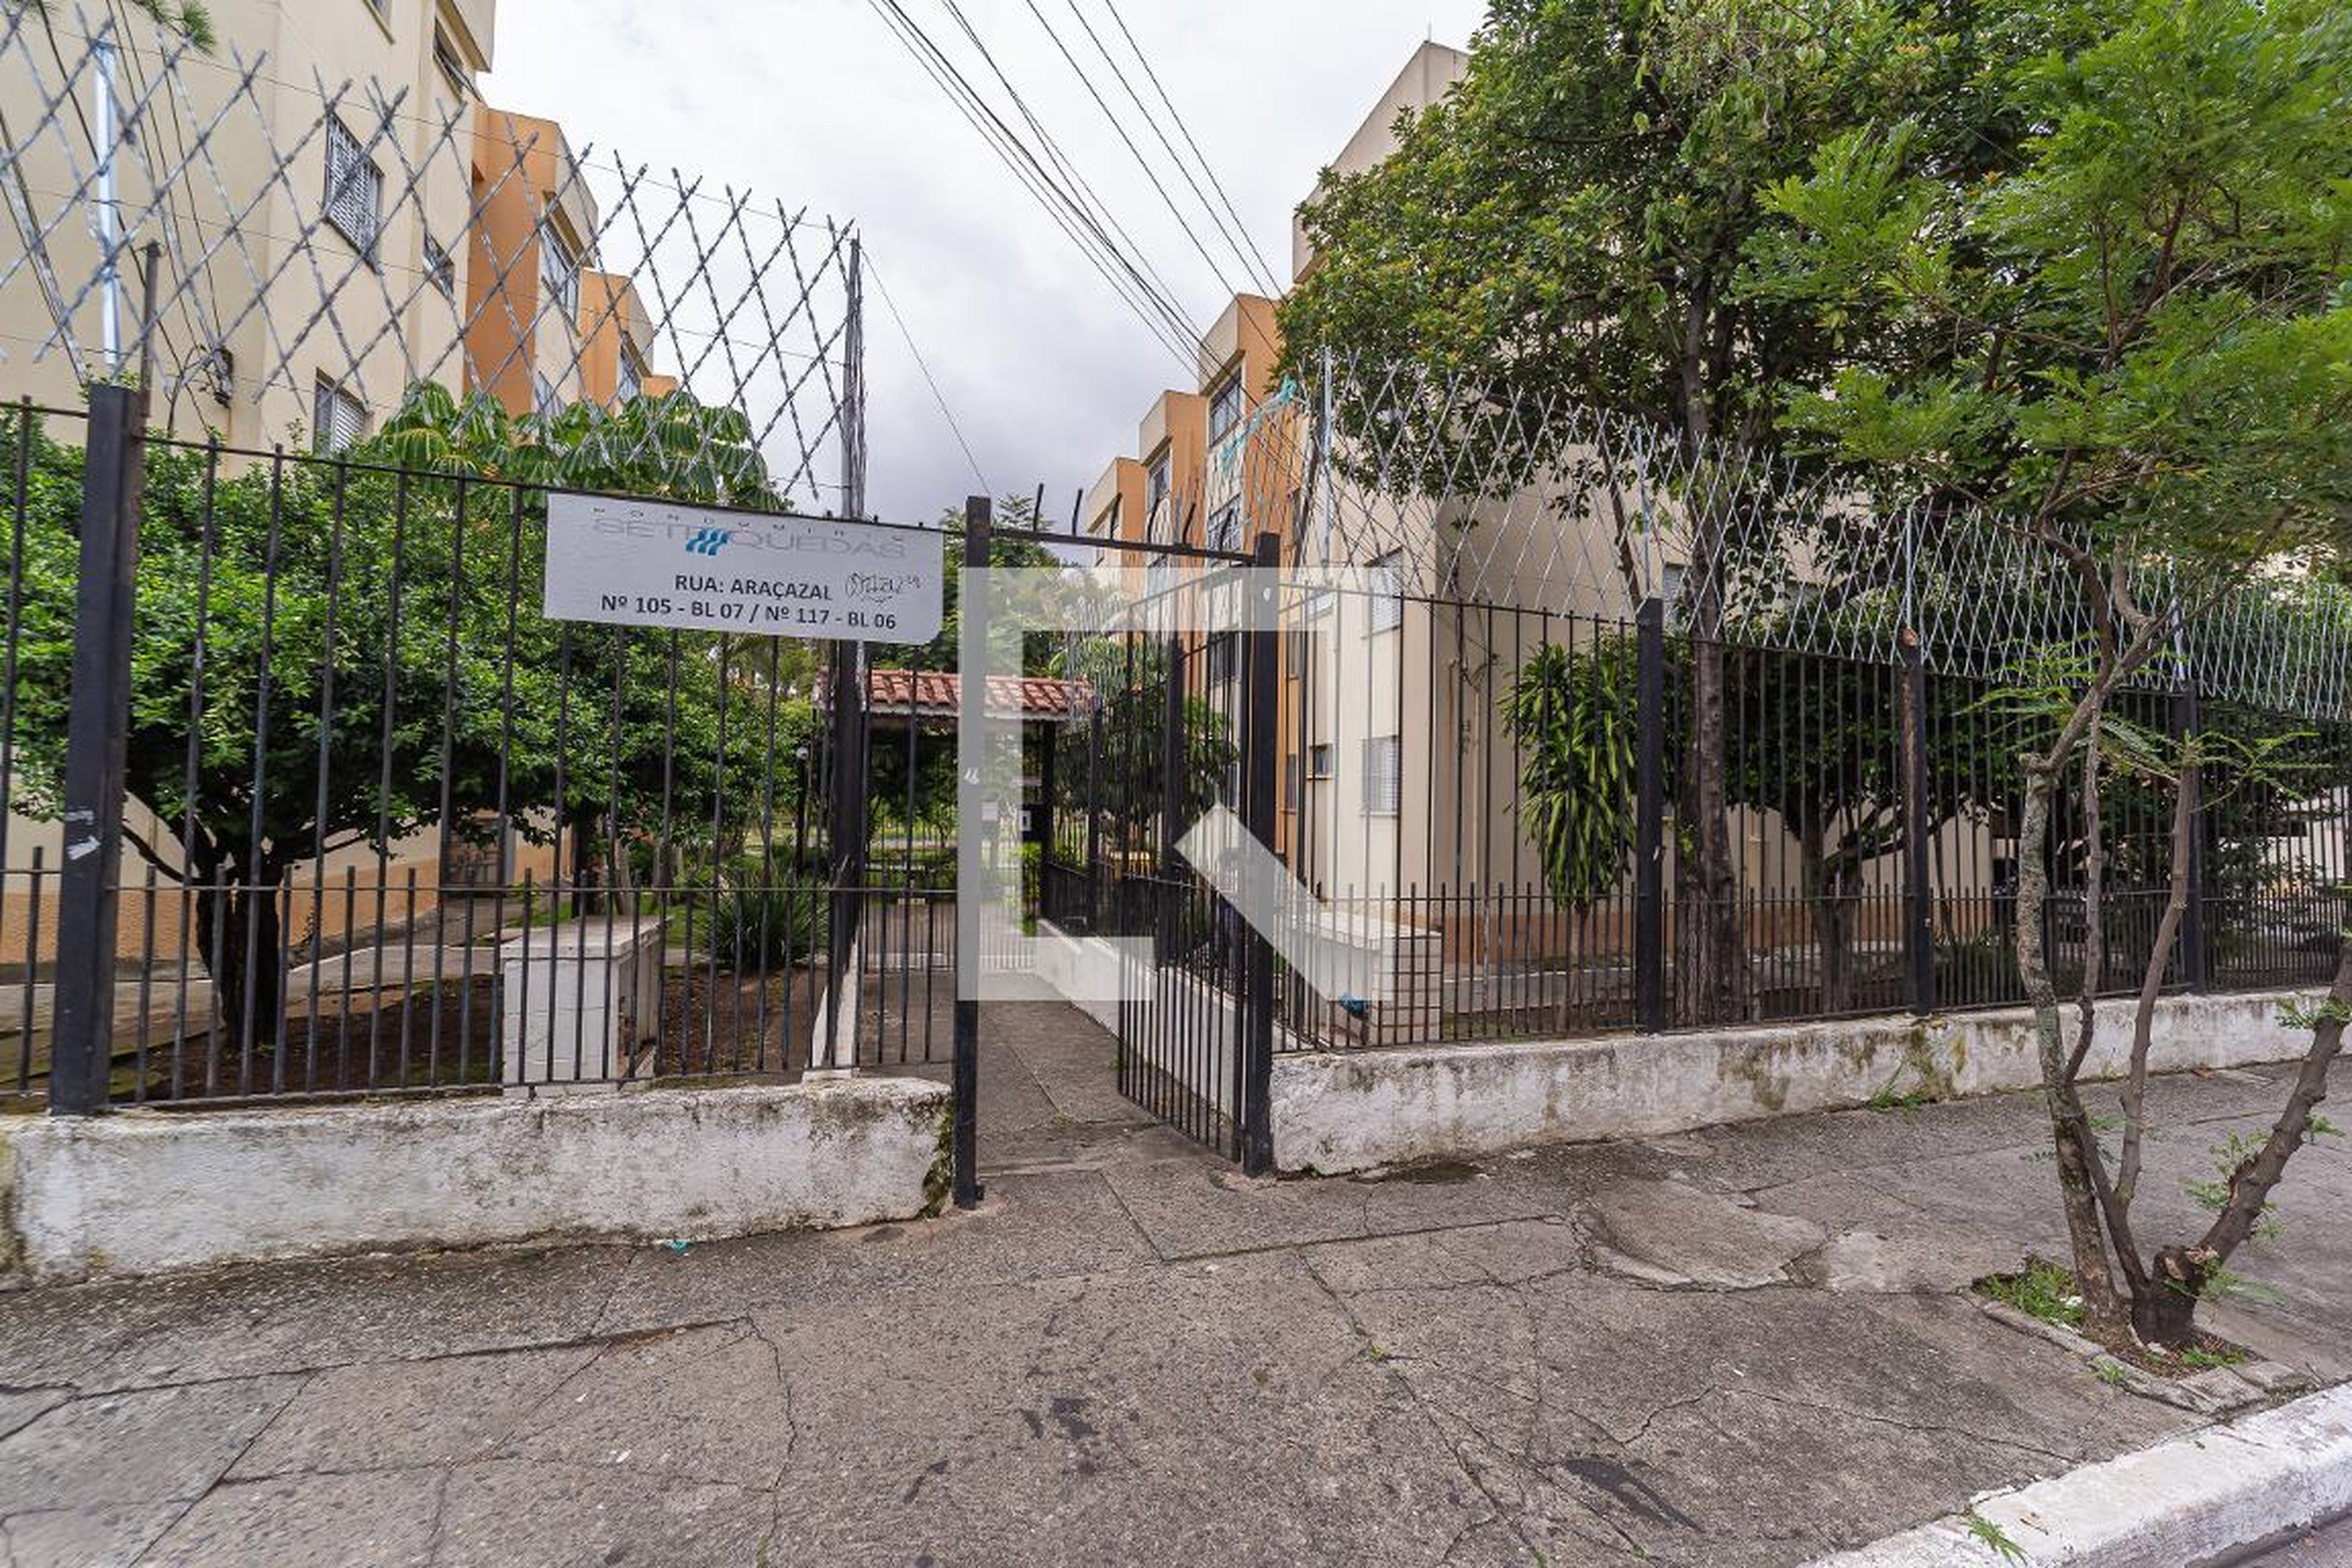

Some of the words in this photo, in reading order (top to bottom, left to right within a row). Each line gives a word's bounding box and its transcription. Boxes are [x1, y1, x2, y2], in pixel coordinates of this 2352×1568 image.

[675, 575, 723, 593] RUA:
[731, 579, 832, 600] ARAÇAZAL
[601, 595, 627, 611] Nº
[636, 597, 671, 614] 105
[691, 601, 714, 617] BL
[720, 603, 744, 619] 07
[748, 604, 759, 624] /
[766, 605, 790, 621] Nº
[798, 608, 829, 624] 117
[848, 612, 869, 627] BL
[875, 613, 895, 629] 06
